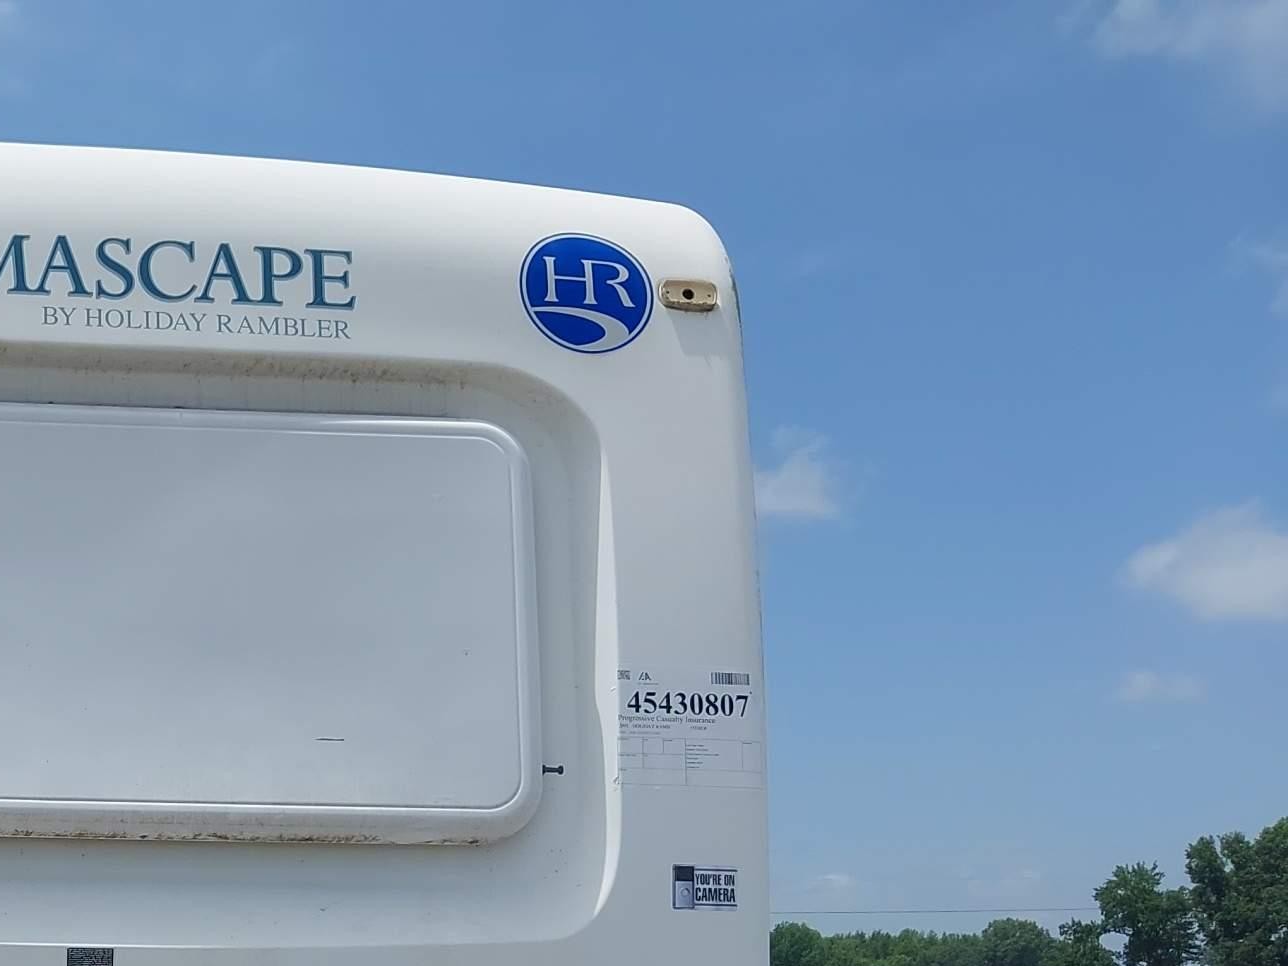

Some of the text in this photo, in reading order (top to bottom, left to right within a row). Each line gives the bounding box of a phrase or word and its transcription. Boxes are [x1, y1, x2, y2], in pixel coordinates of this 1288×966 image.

[541, 256, 636, 308] HR
[41, 306, 352, 339] BY HOLIDAY RAMBLER
[627, 690, 749, 717] 45430807
[618, 714, 655, 722] Progressive
[656, 715, 683, 724] Casualty
[695, 873, 735, 887] YOU'RE ON
[695, 887, 736, 903] CAMERA
